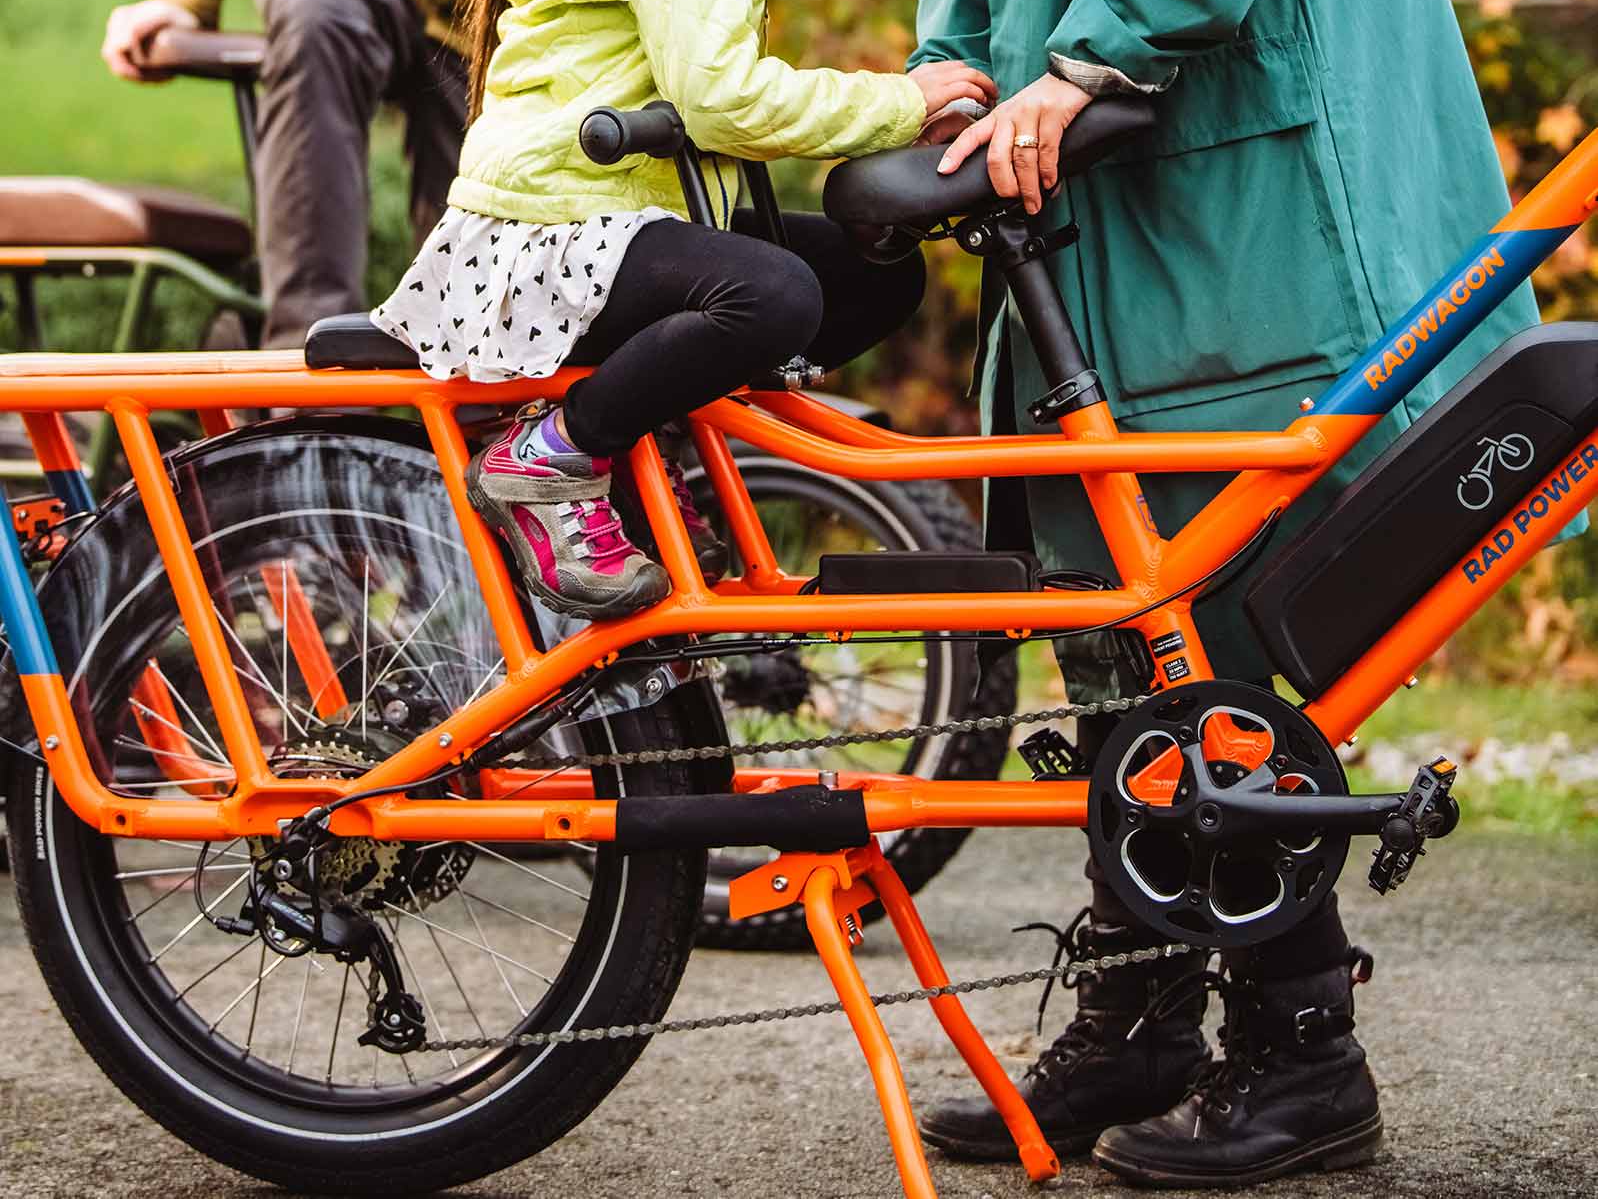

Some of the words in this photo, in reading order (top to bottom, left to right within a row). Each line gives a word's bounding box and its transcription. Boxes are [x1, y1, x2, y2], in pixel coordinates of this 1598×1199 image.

[1362, 247, 1505, 391] RADWAGON
[1462, 528, 1515, 584] RAD
[1512, 444, 1598, 535] POWER
[35, 766, 44, 795] BIKES
[35, 797, 43, 836] POWER
